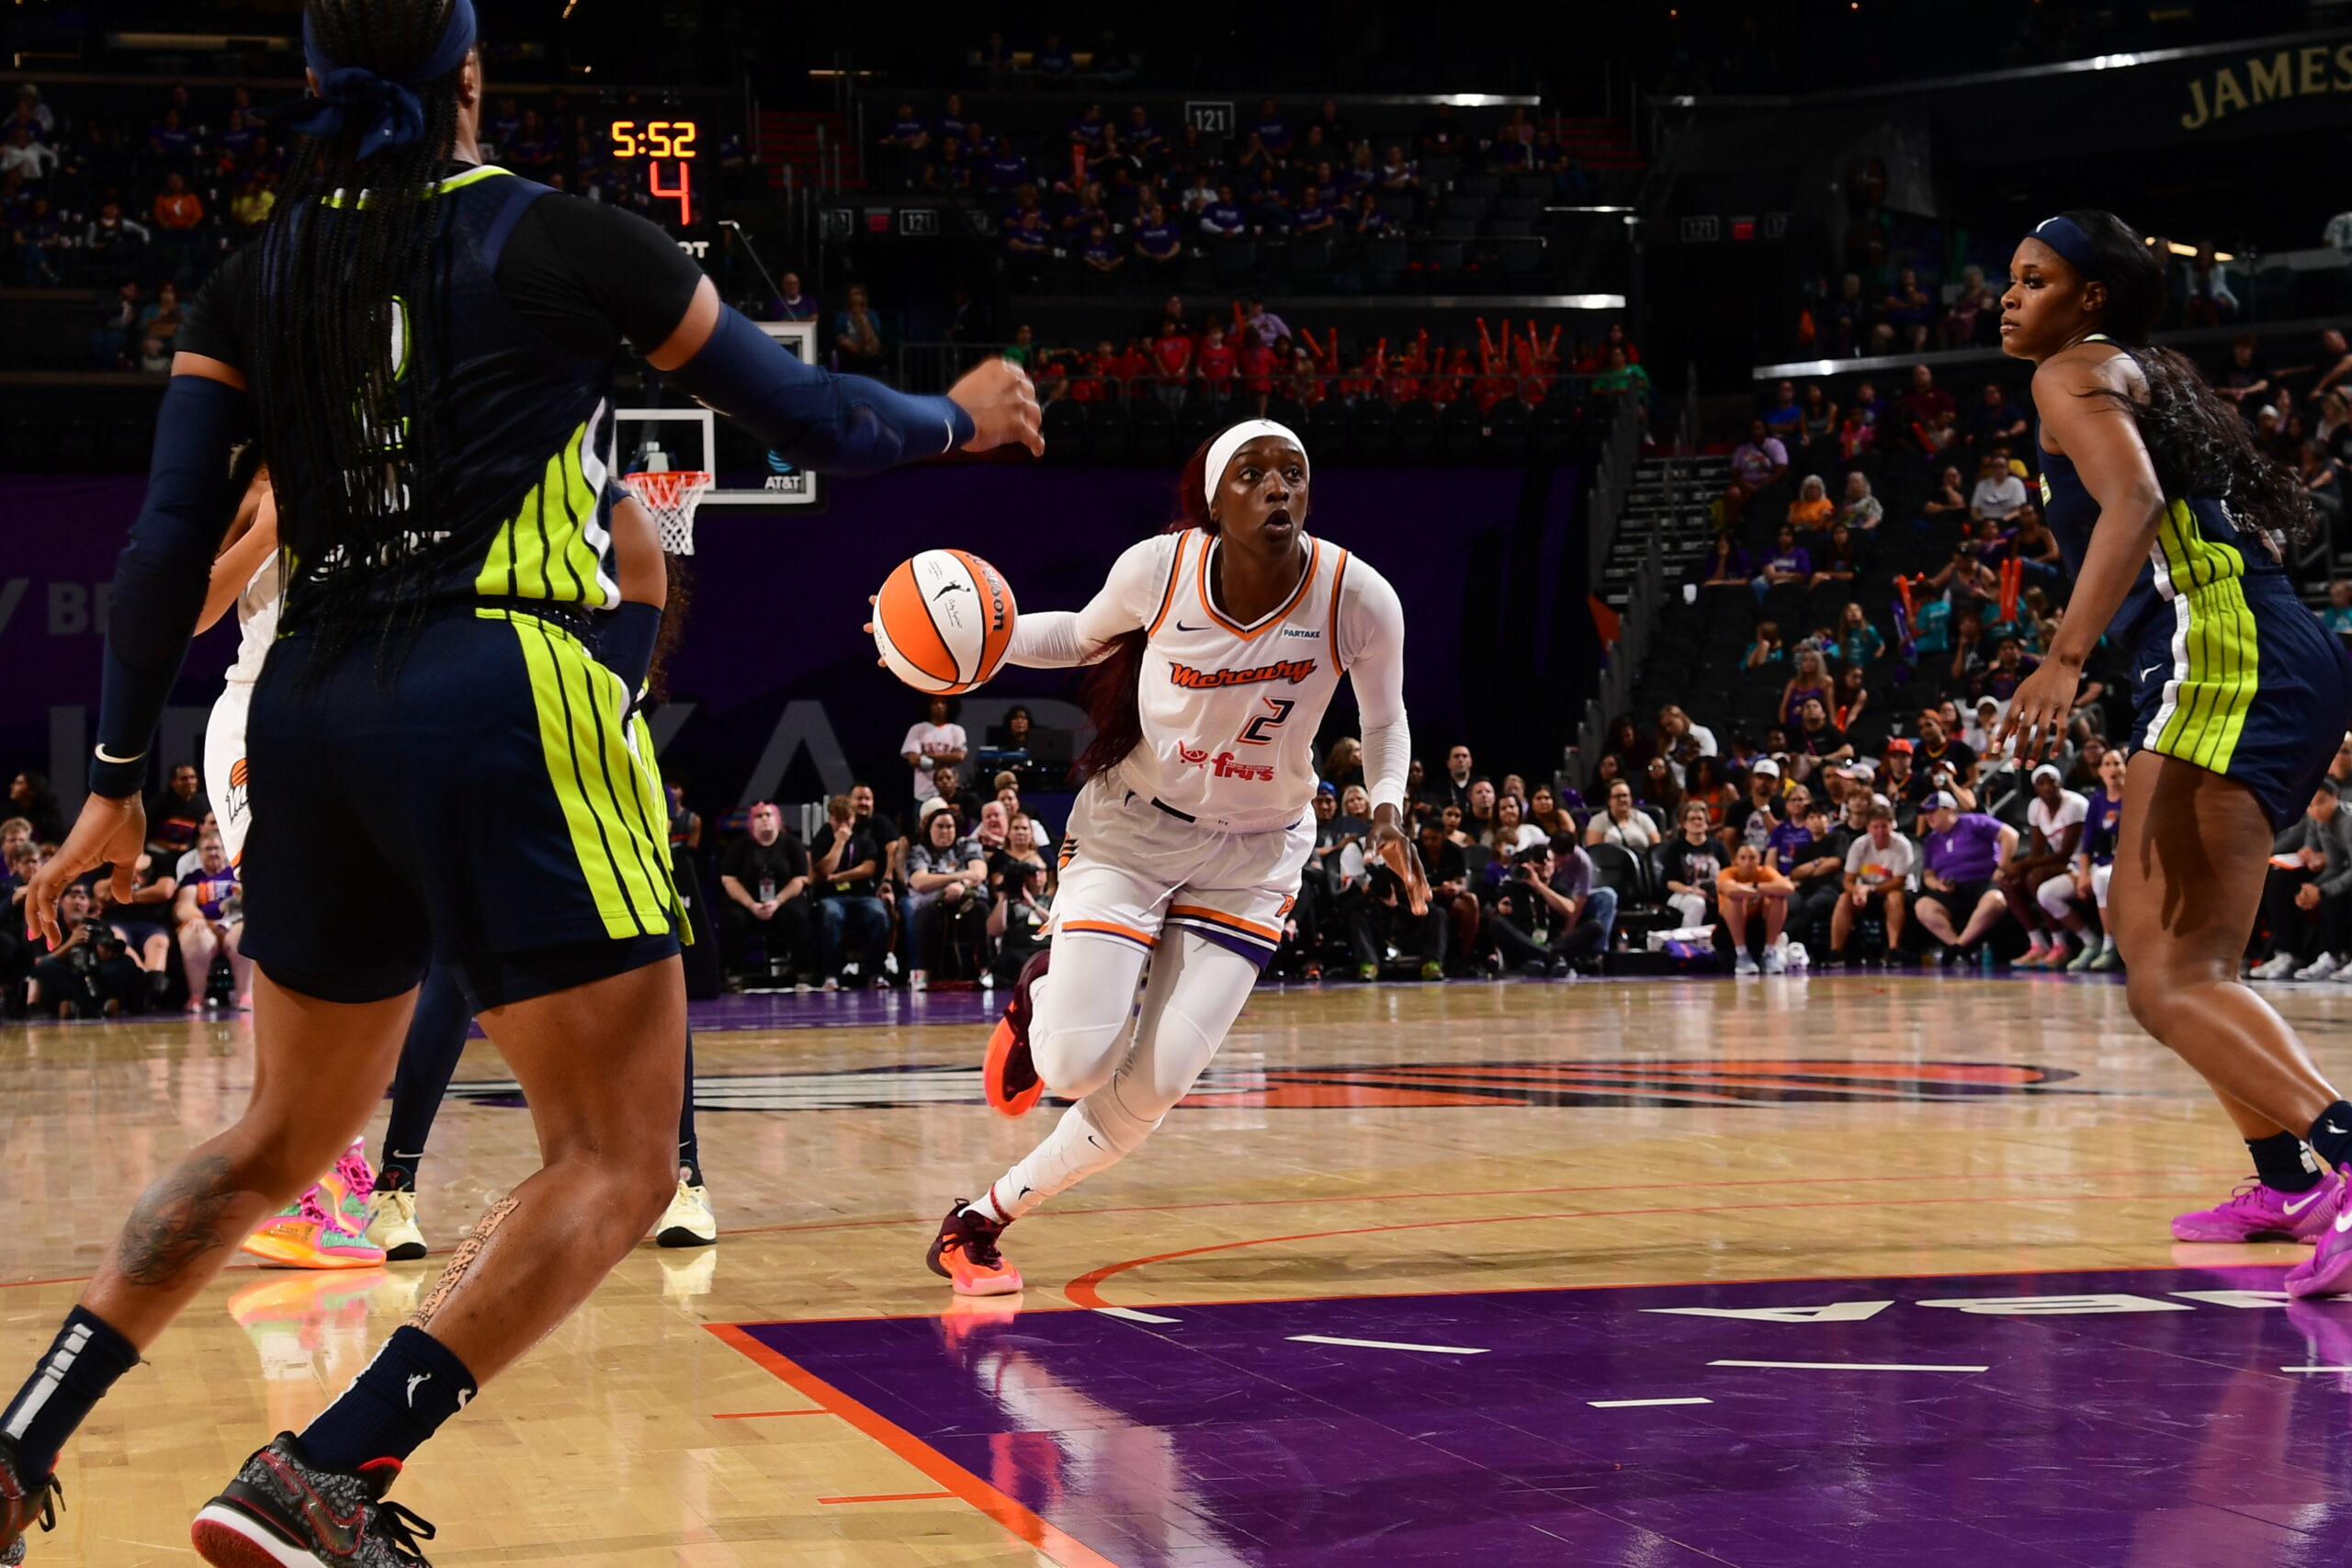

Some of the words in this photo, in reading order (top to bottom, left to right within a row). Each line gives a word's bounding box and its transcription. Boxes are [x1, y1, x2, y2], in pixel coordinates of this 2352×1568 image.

[2179, 44, 2352, 130] JAMES
[1194, 109, 1225, 131] 121
[611, 120, 697, 158] 5:52
[649, 160, 691, 226] 4
[764, 475, 801, 491] AT&T
[1283, 629, 1321, 638] PARTAKE
[1168, 658, 1318, 689] Mercury
[1236, 696, 1295, 745] 2
[1211, 751, 1274, 782] fry's
